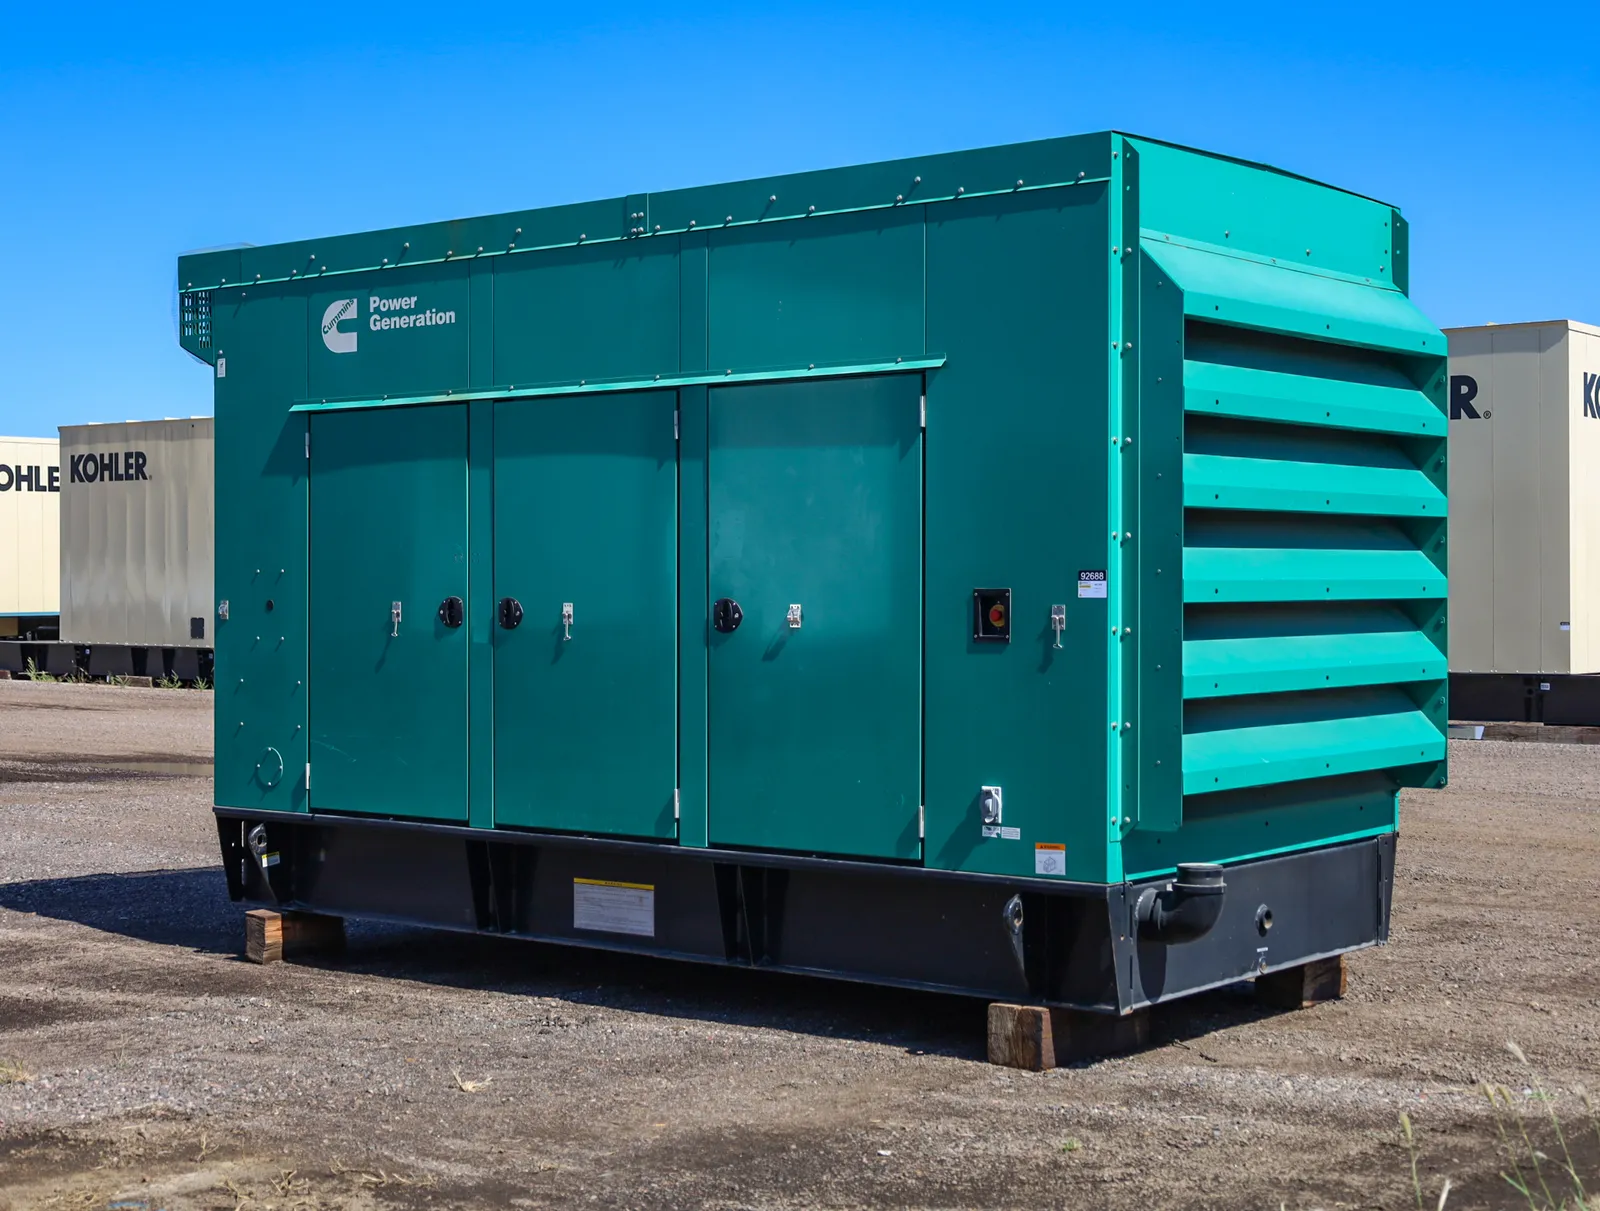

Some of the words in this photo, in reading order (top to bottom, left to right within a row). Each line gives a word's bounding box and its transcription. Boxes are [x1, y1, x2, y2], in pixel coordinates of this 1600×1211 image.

[369, 296, 417, 312] Power
[322, 299, 355, 335] Cummins
[369, 308, 456, 331] Generation
[70, 451, 148, 483] KOHLER
[1080, 572, 1104, 580] 92688
